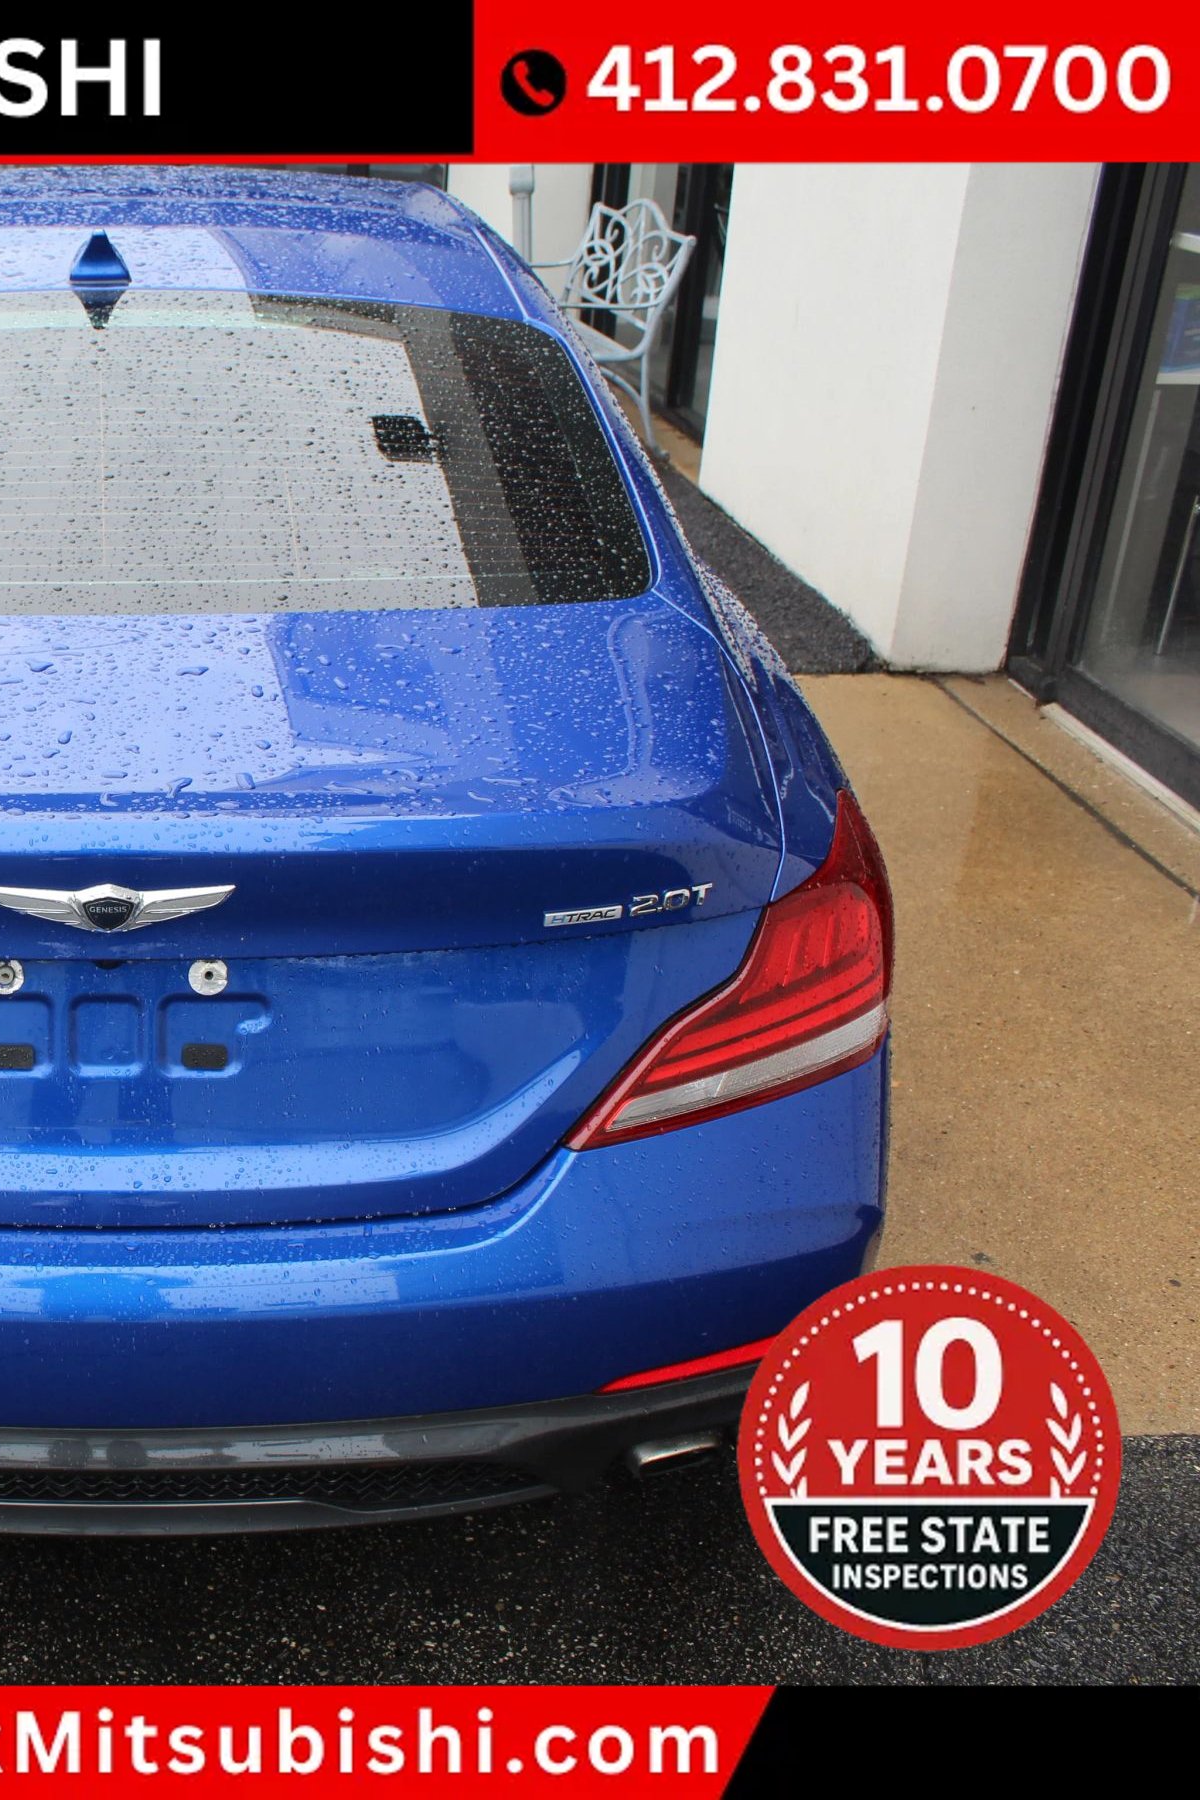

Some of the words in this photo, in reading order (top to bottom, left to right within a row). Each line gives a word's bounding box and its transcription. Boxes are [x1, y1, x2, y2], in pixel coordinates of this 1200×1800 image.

[89, 906, 128, 914] GENESIS
[552, 908, 617, 924] HTRAC
[629, 882, 713, 917] 2.0T
